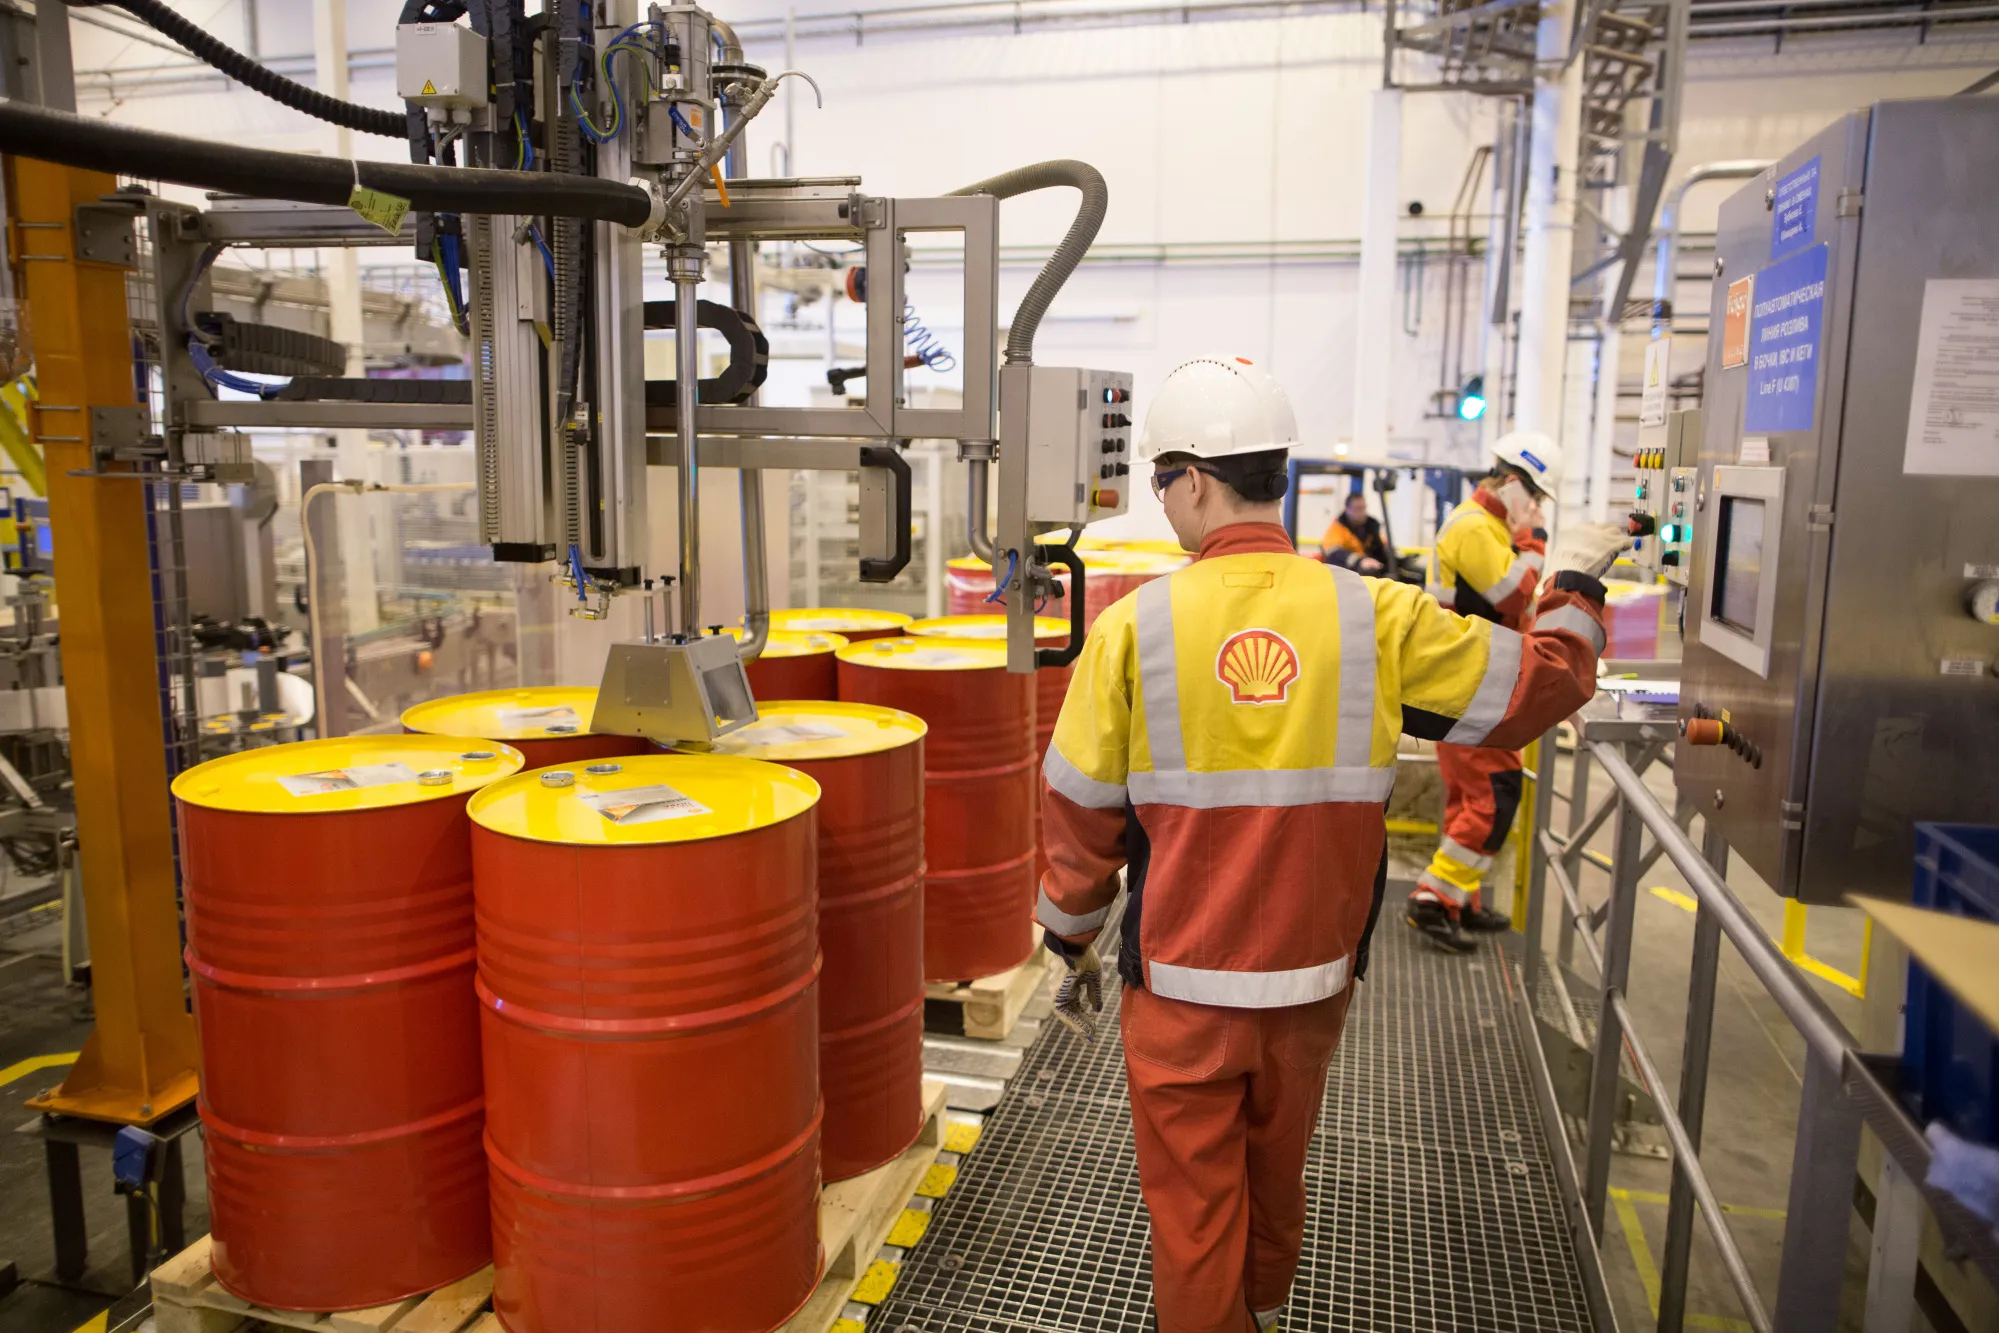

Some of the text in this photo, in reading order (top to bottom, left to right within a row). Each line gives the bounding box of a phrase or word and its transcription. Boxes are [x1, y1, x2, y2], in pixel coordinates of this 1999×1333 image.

[1754, 280, 1825, 318] ПОЛУАВТОМАТИЧЕСКАЯ
[1760, 315, 1809, 343] ЛИНИЯ РОЗЛИВА
[1754, 355, 1759, 370] В
